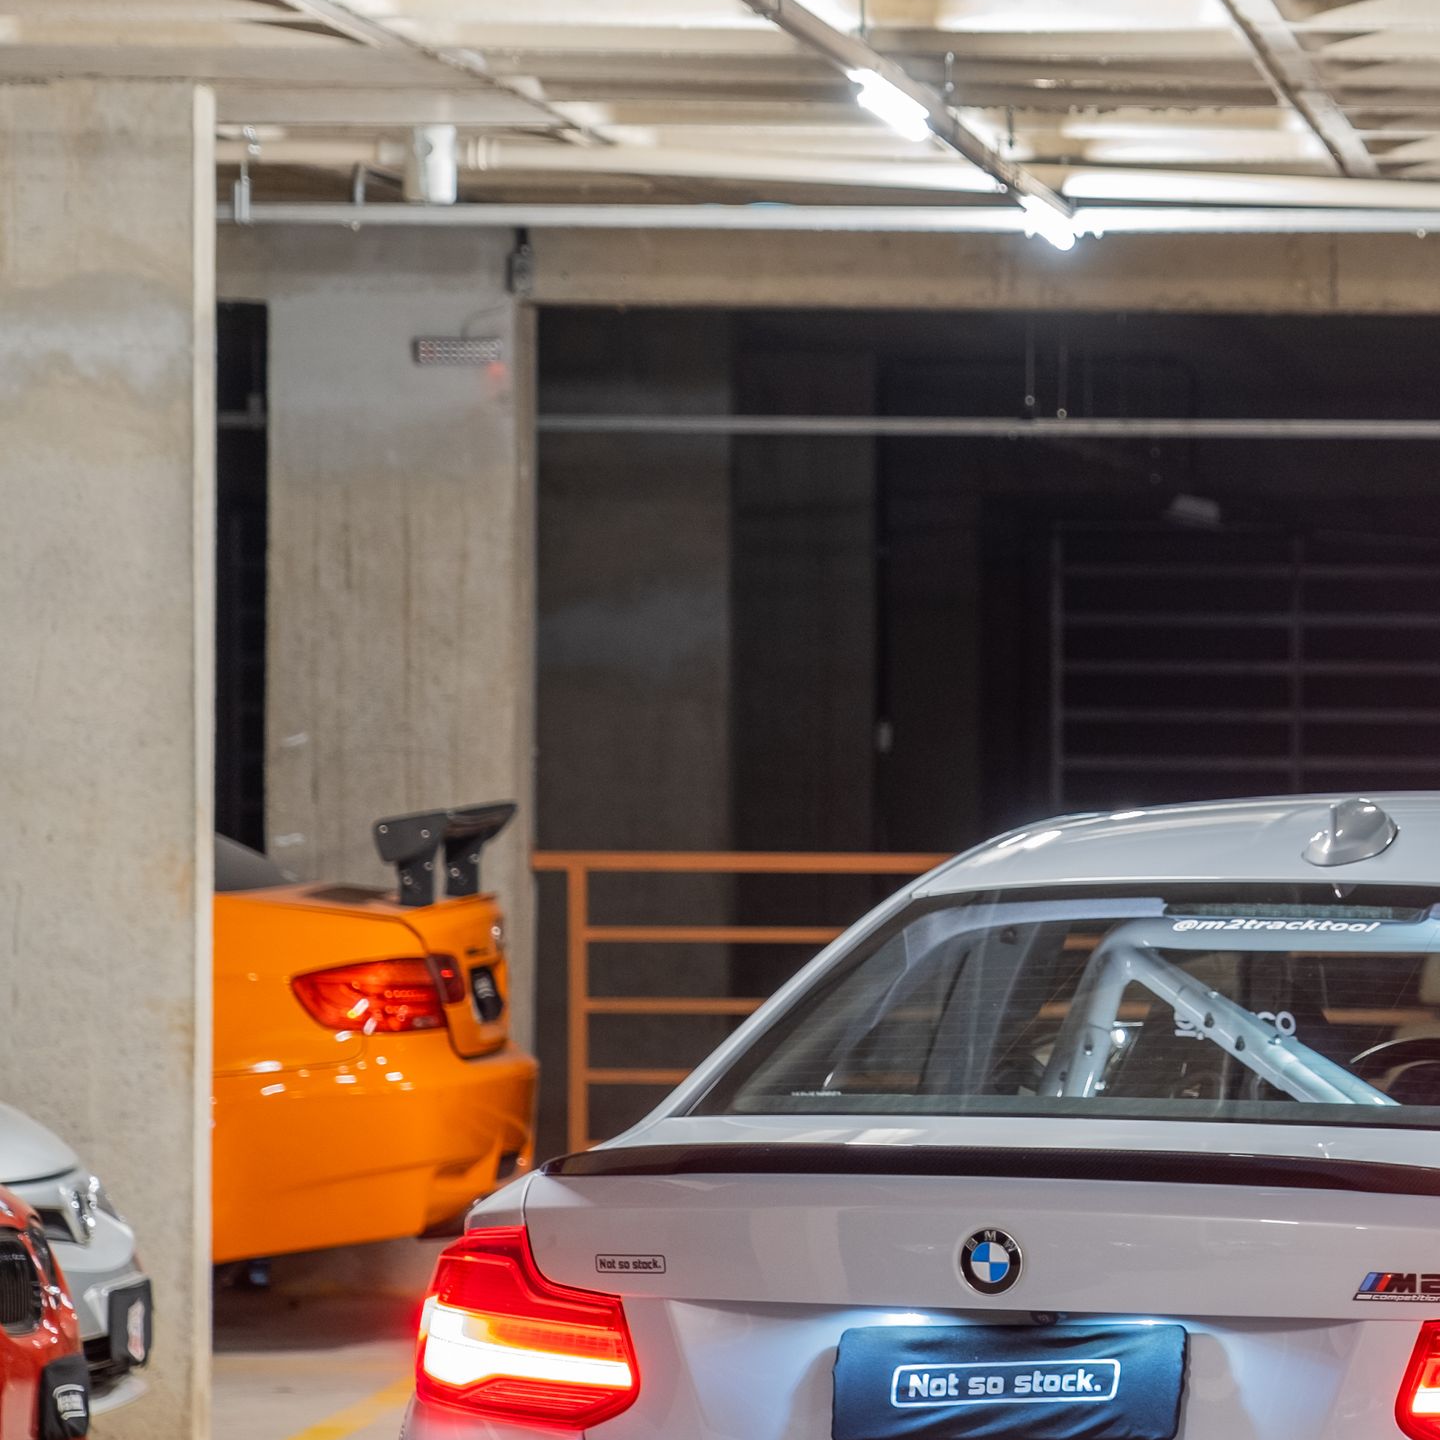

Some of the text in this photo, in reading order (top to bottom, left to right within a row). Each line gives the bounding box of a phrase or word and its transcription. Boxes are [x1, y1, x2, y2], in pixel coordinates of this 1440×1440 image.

[1172, 919, 1382, 933] @m2tracktool
[965, 1230, 1017, 1253] BMW
[599, 1258, 661, 1270] Not so stock.
[908, 1368, 1102, 1398] Not so stock.
